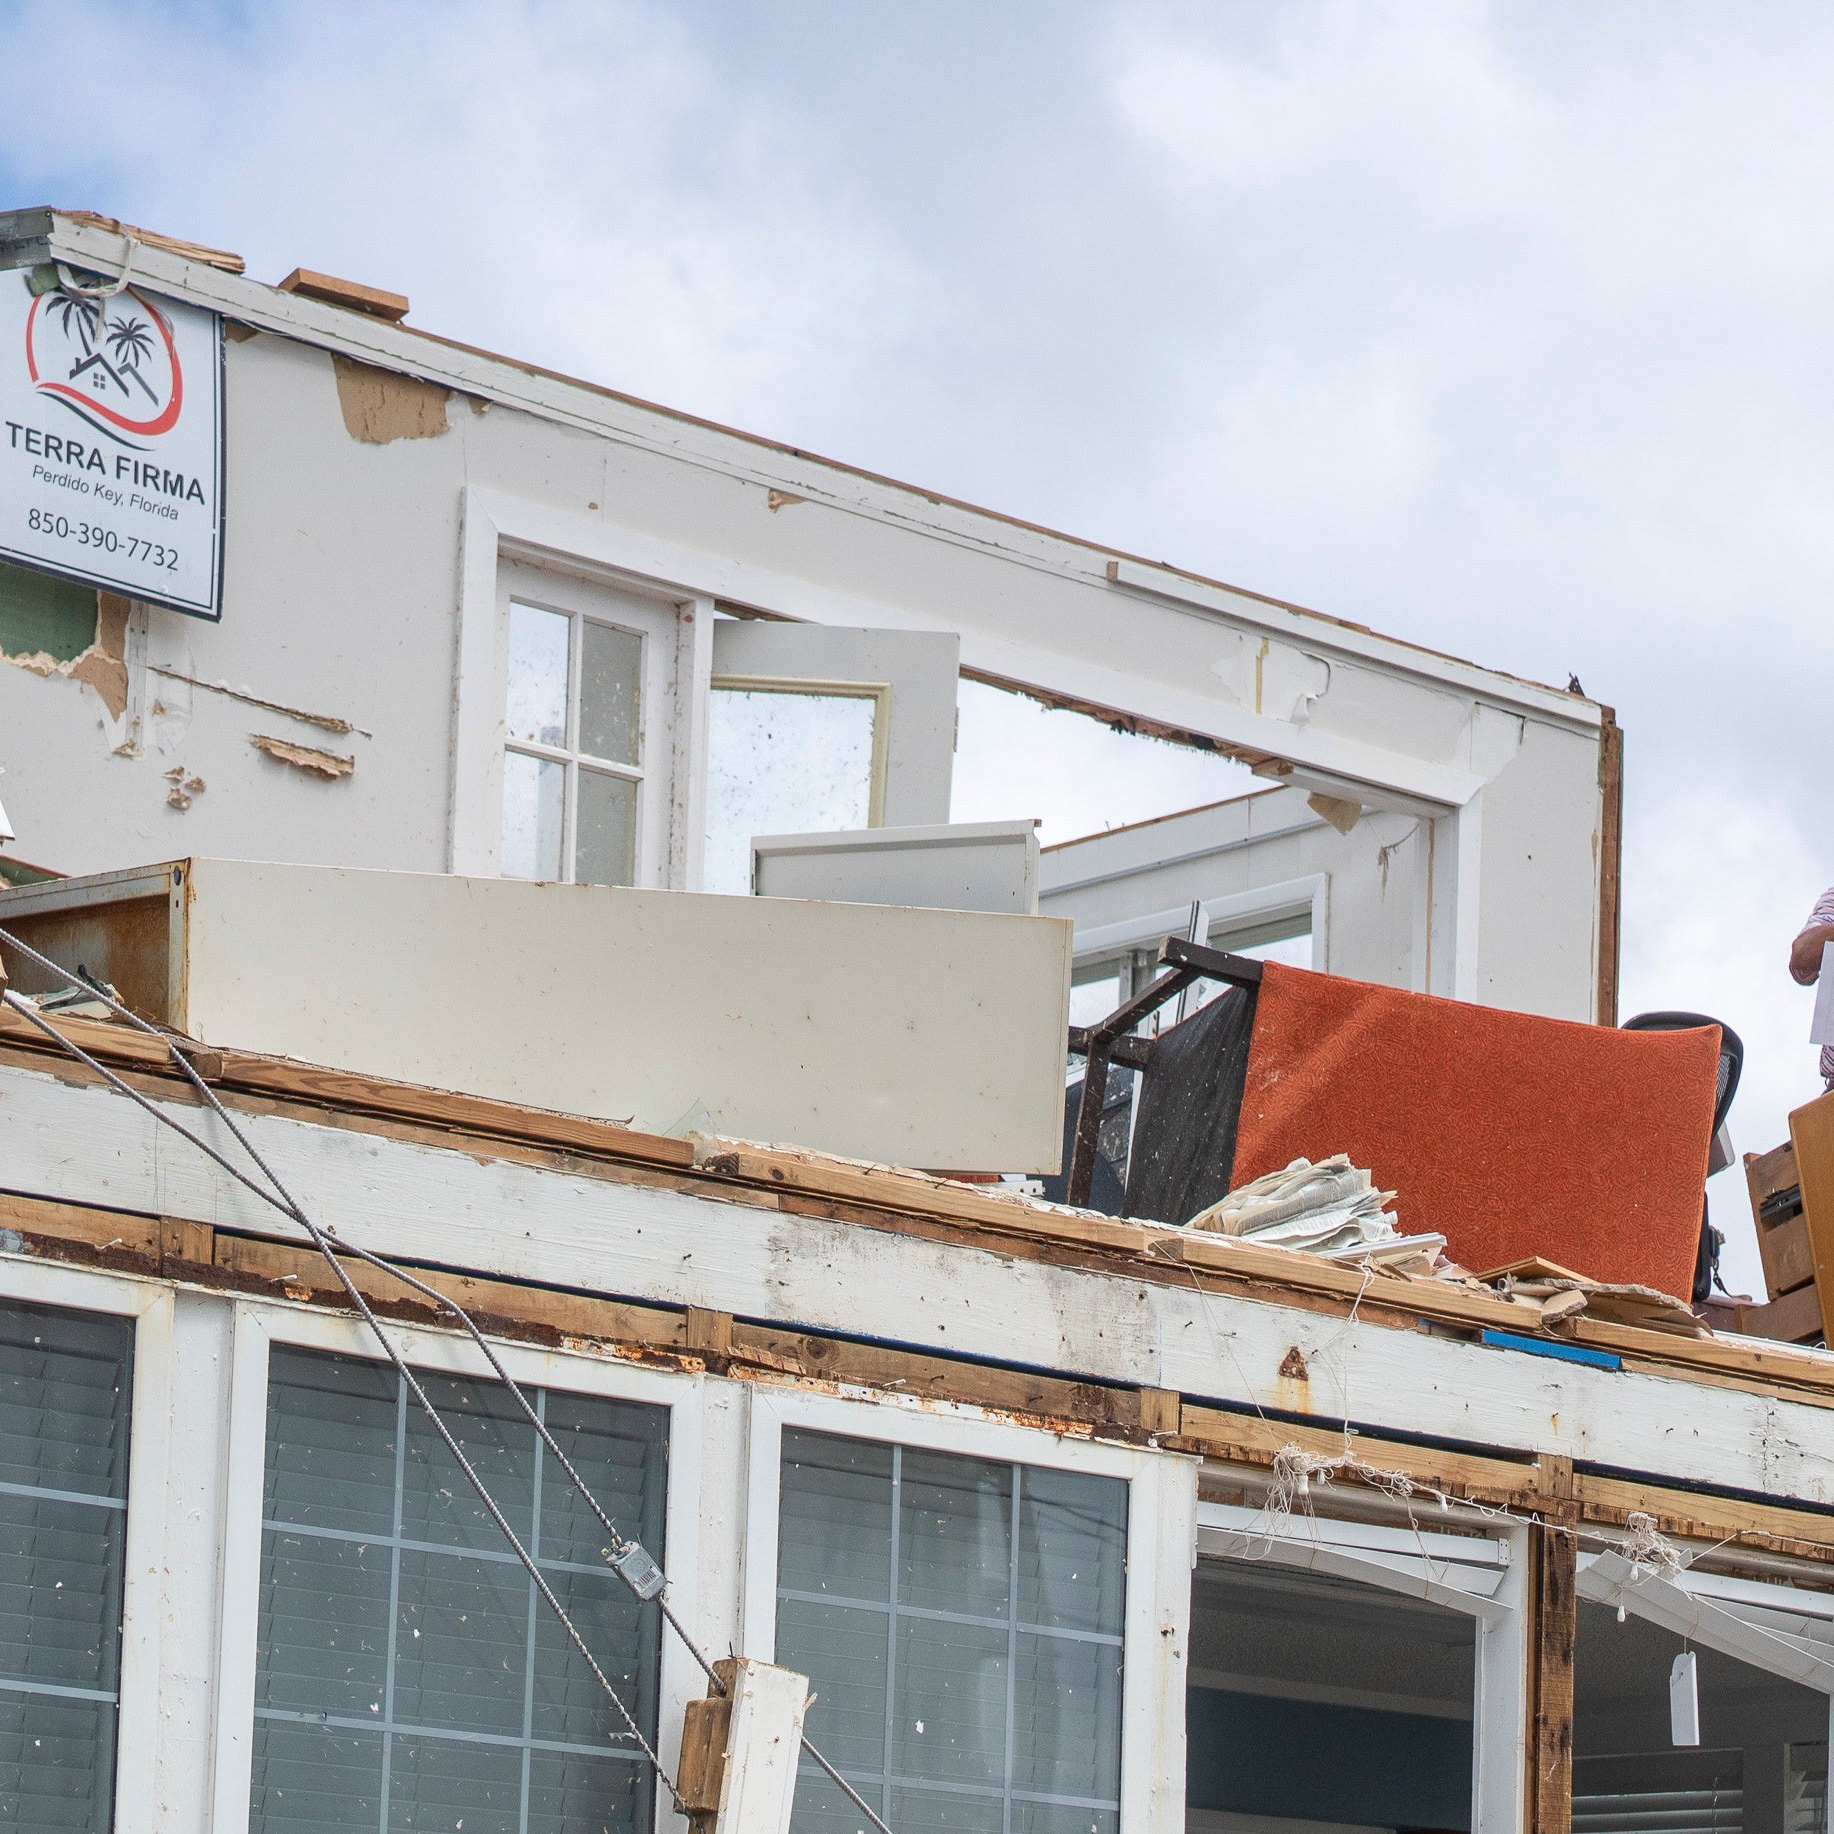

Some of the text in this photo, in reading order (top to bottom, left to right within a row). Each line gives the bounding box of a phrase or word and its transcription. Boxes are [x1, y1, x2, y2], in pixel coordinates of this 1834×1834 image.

[5, 420, 205, 506] TERRA FIRMA
[32, 464, 179, 521] Perdido Key, Florida
[28, 508, 179, 571] 850-390-7732
